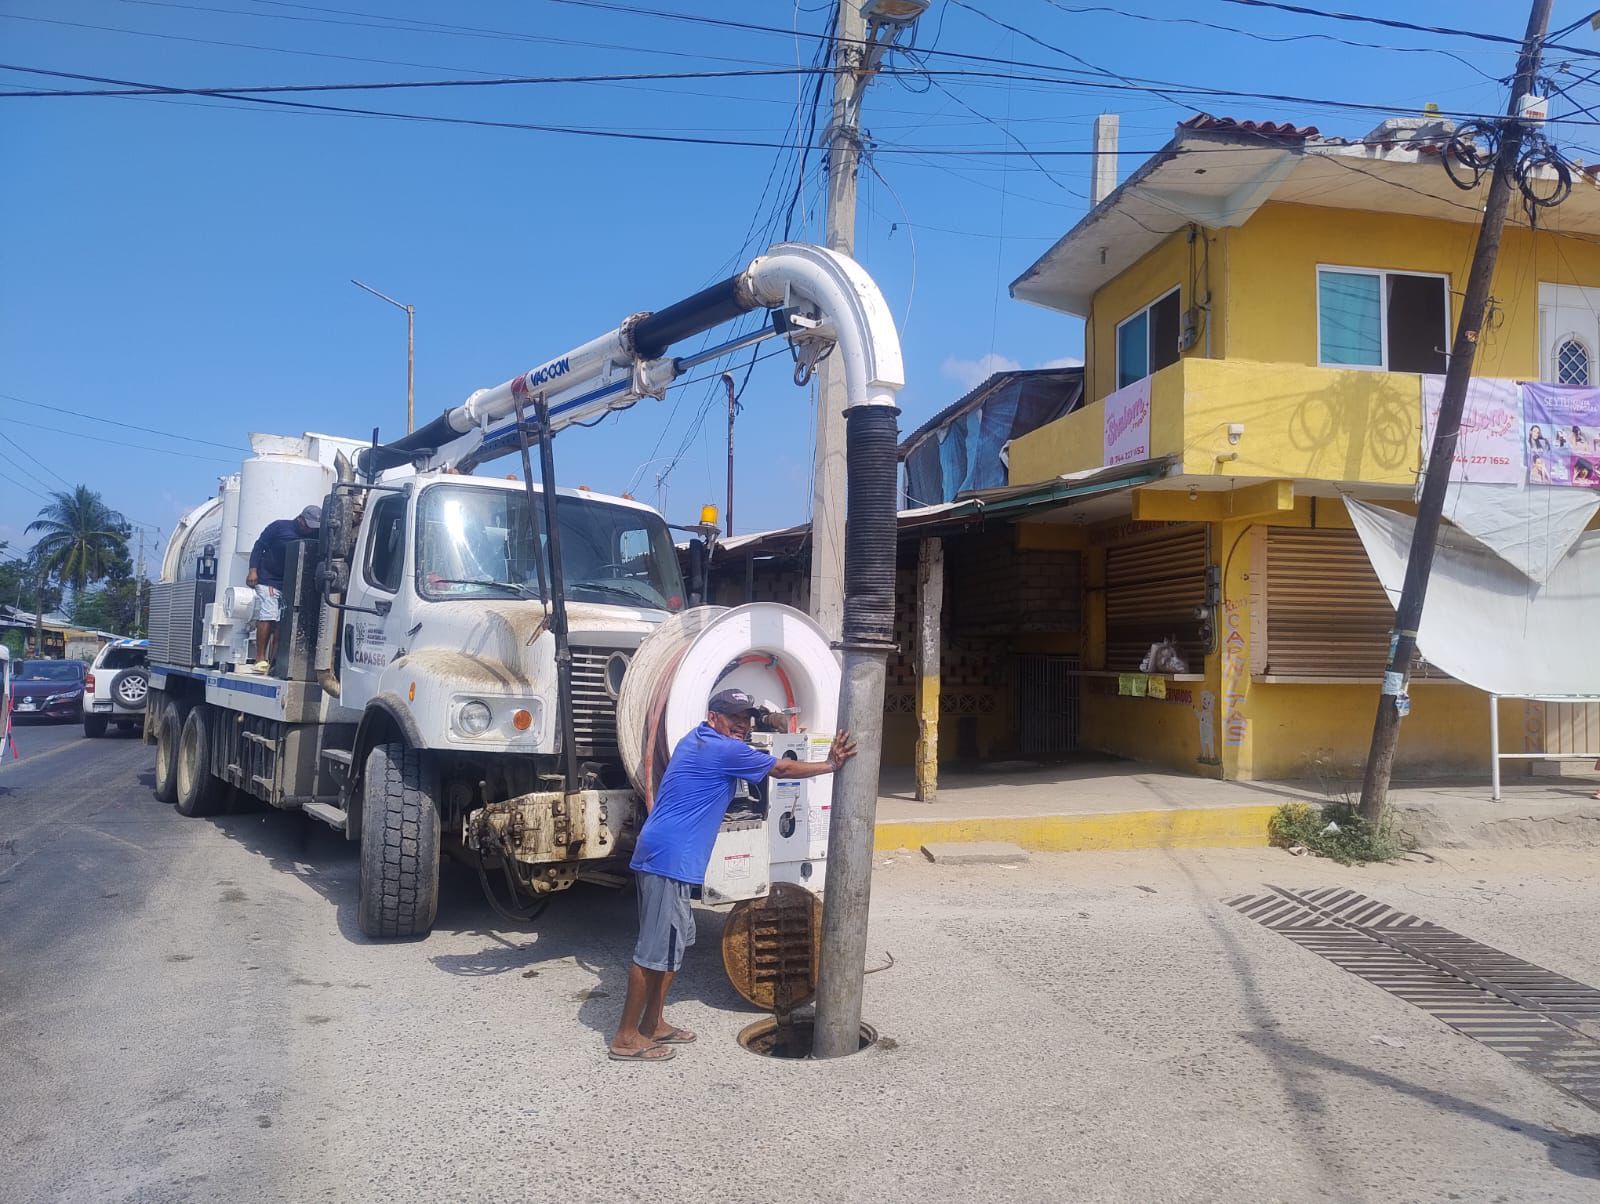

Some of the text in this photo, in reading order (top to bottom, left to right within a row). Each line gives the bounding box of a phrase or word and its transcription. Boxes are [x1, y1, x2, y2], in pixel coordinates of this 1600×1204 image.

[1107, 398, 1144, 446] Shalom
[1460, 407, 1508, 437] alom
[1490, 422, 1512, 438] STUDIO
[1471, 456, 1487, 465] 227
[1489, 456, 1511, 465] 1652
[355, 650, 386, 667] CAPASEG
